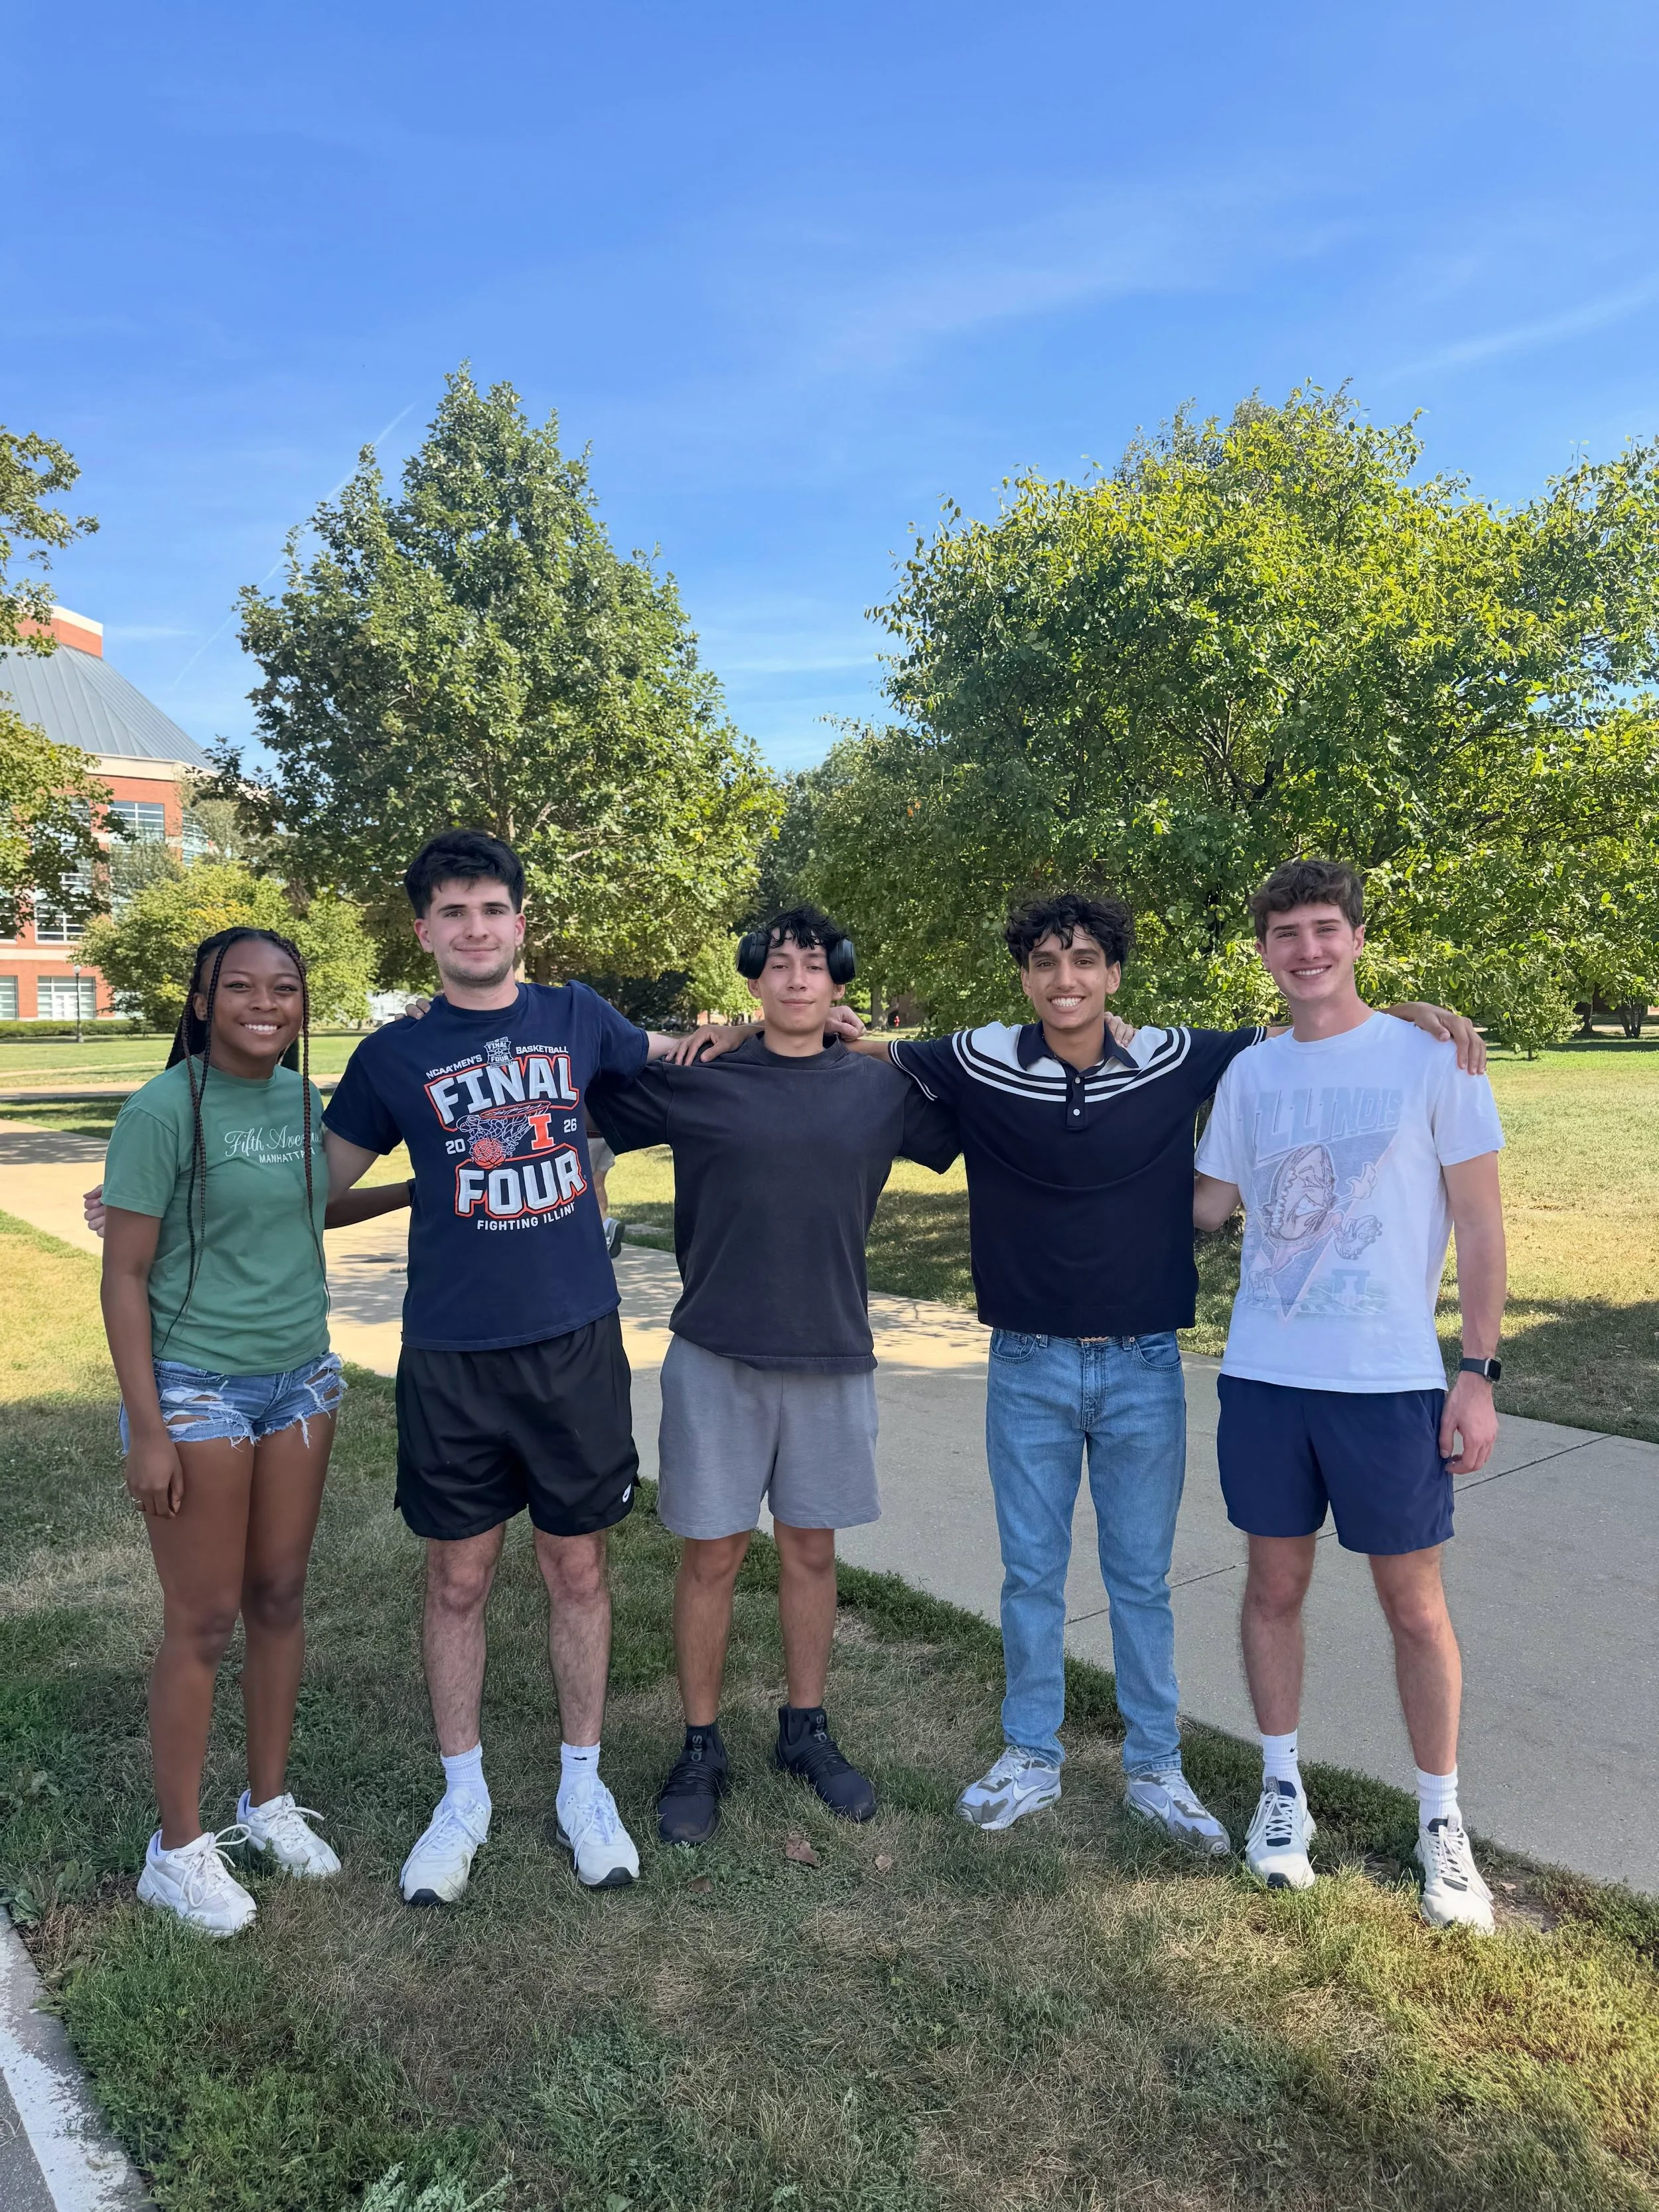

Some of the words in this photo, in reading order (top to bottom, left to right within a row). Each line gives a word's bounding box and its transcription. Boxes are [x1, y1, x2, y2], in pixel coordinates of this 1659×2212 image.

[453, 1054, 483, 1070] MEN'S
[515, 1045, 569, 1055] BASKETBALL
[487, 1041, 508, 1051] FINAL
[428, 1057, 578, 1126] FINAL
[563, 1118, 577, 1134] 26
[224, 1127, 264, 1157] Fifth
[445, 1138, 466, 1155] 20
[458, 1149, 585, 1215] FOUR
[476, 1216, 539, 1231] FIGHTING
[543, 1202, 575, 1224] ILLINI
